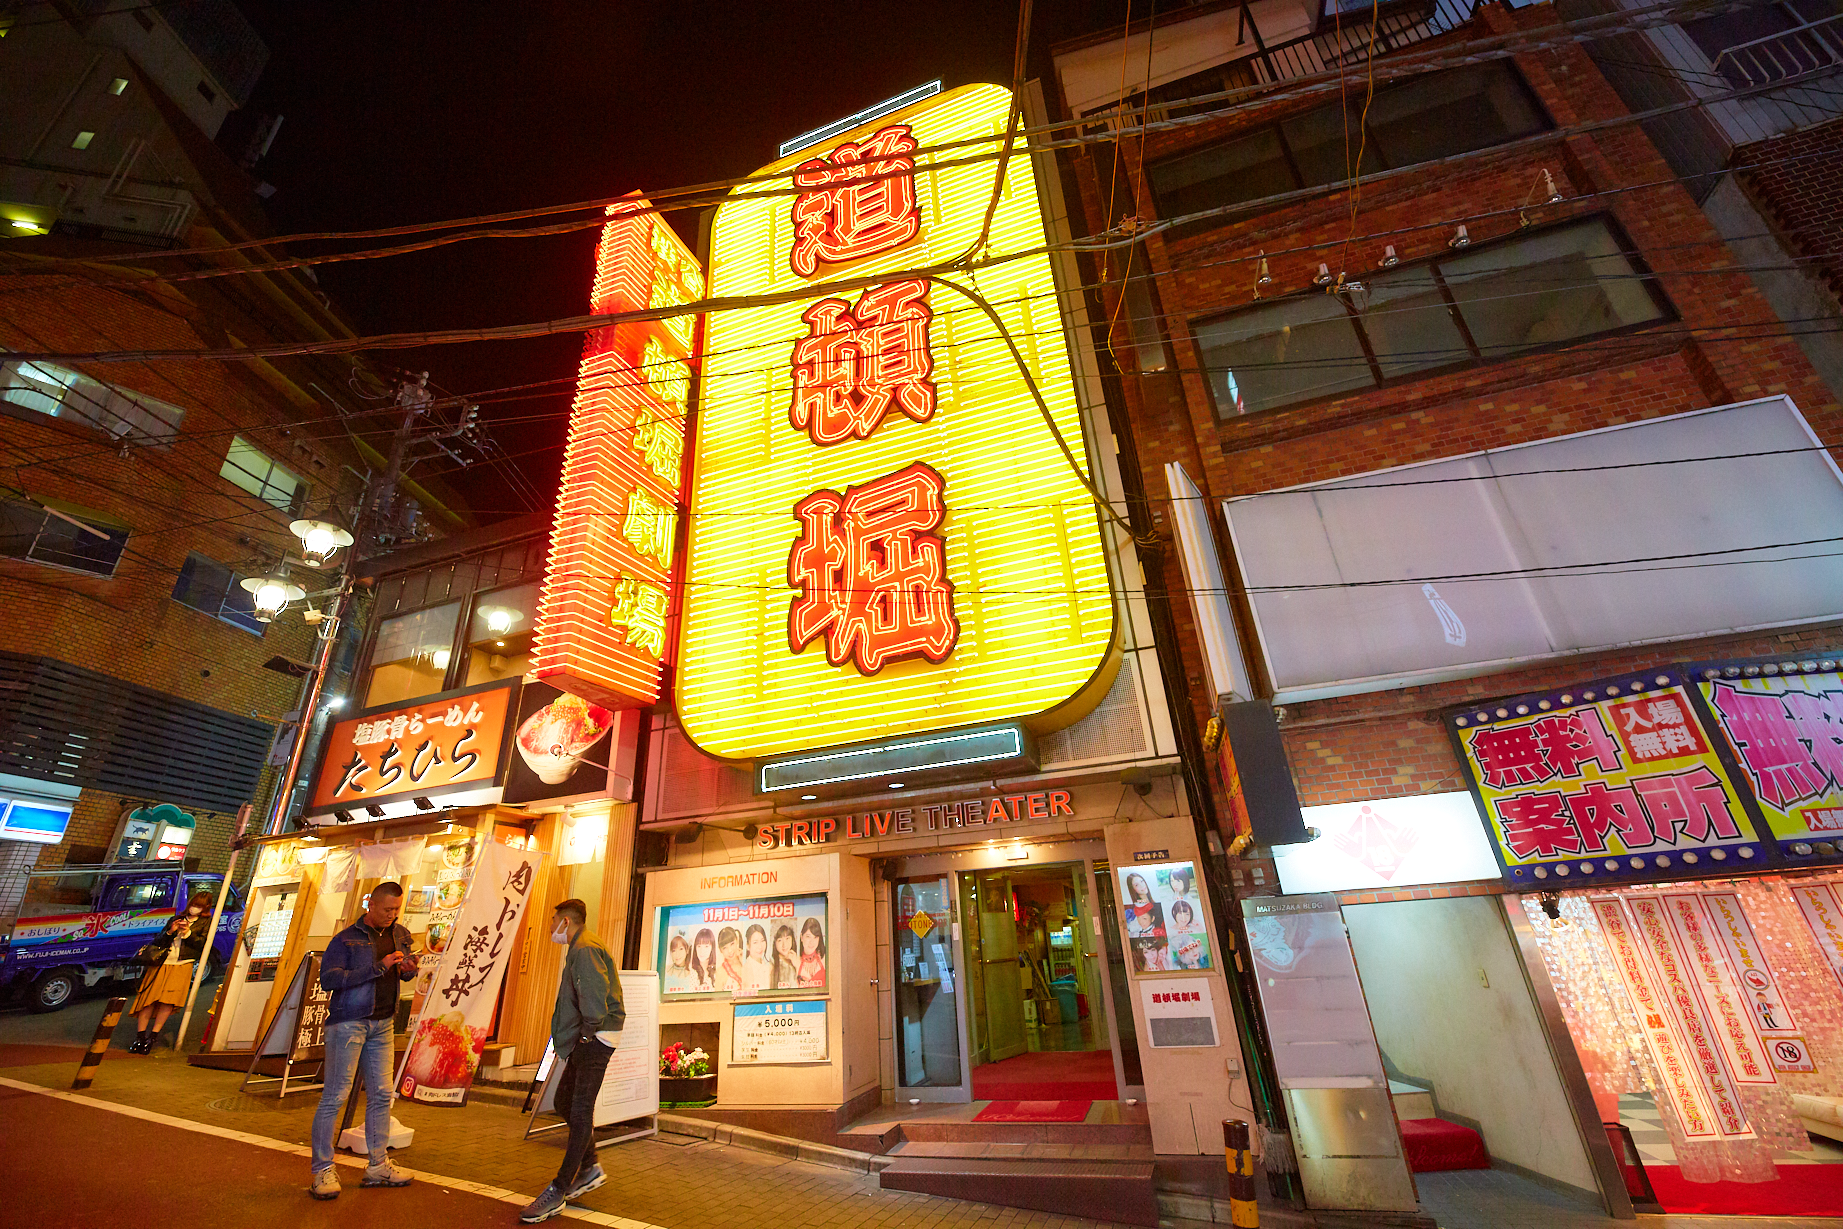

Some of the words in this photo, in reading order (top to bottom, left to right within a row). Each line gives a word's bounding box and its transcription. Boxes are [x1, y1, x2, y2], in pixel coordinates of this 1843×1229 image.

[787, 124, 961, 677] 道頓堀
[610, 266, 697, 660] 道頓堀劇場
[352, 701, 485, 745] 塩豚骨らーめん
[1620, 699, 1685, 732] 入場
[331, 729, 480, 797] たちひら
[1468, 706, 1624, 790] 無料
[1630, 725, 1698, 759] 無料
[757, 818, 837, 850] STRIP
[846, 809, 914, 839] LIVE
[922, 790, 1075, 830] THEATER
[1494, 765, 1743, 860] 案内所
[700, 871, 778, 890] INFORMATION
[84, 913, 111, 938] 氷
[468, 860, 533, 991] 肉ドレス
[1256, 904, 1301, 913] MATSUZAKA
[1302, 901, 1323, 910] BLDG
[27, 926, 61, 937] おしぼり
[1714, 897, 1755, 968] いらっしゃいませ
[1152, 992, 1200, 1003] 道頓堀劇場
[1780, 1046, 1798, 1060] 18
